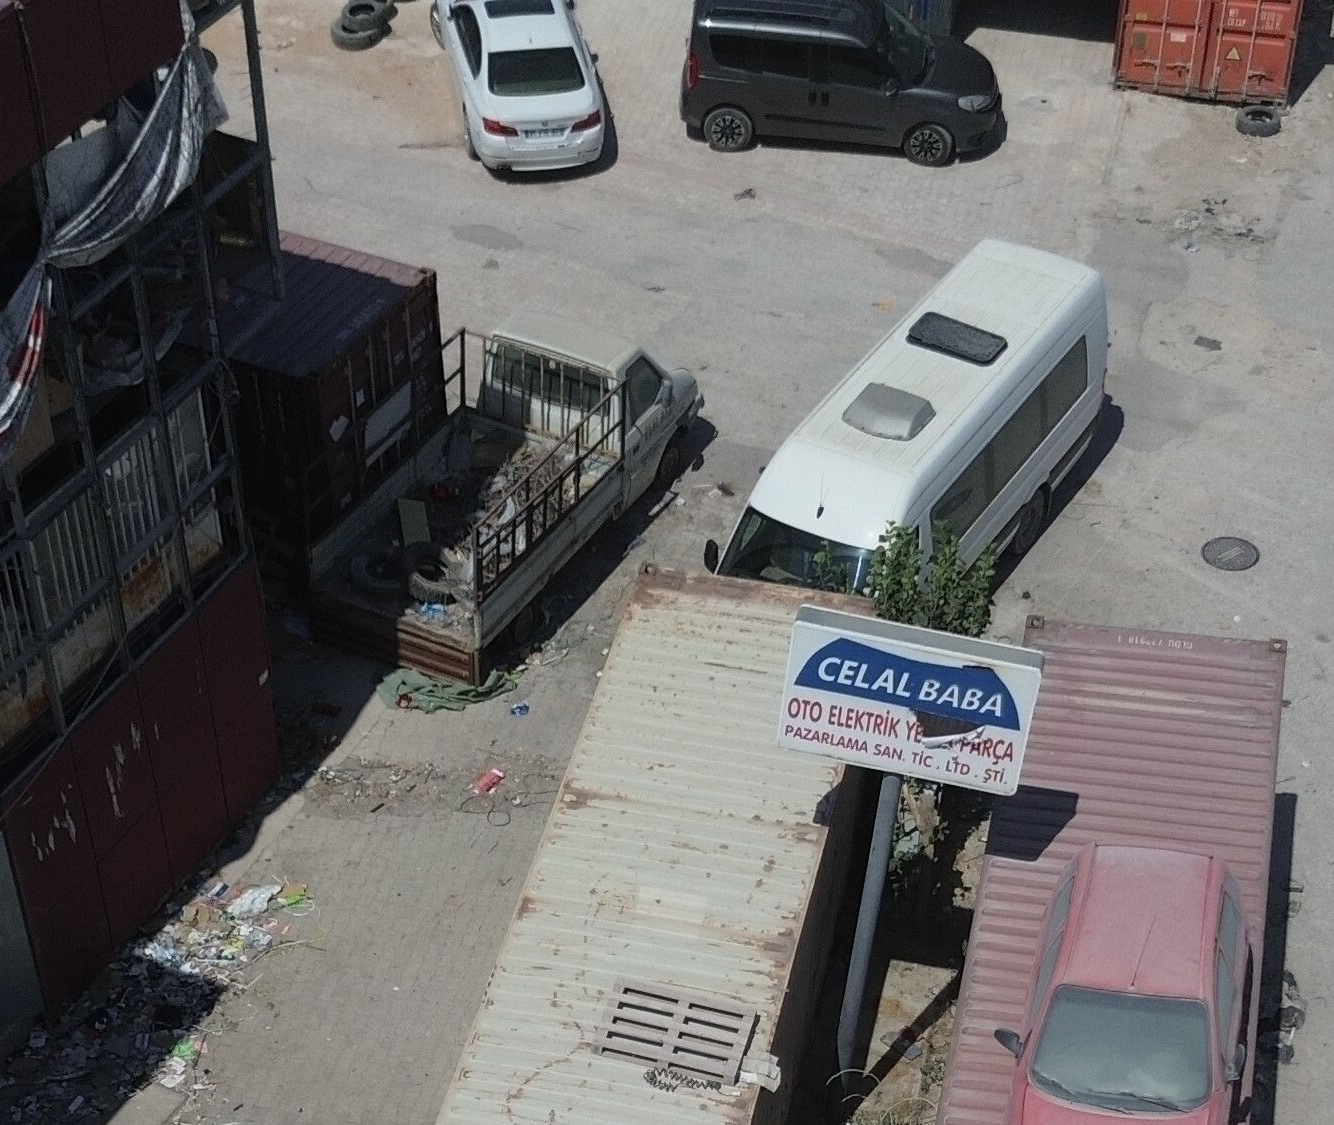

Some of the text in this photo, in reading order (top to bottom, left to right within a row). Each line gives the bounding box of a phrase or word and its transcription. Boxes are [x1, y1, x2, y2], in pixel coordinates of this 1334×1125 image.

[817, 657, 1003, 717] CELAL BABA
[787, 698, 823, 723] OTO
[828, 704, 901, 739] ELEKTRİK
[784, 724, 868, 753] PAZARLAMA
[873, 743, 906, 762] SAN.
